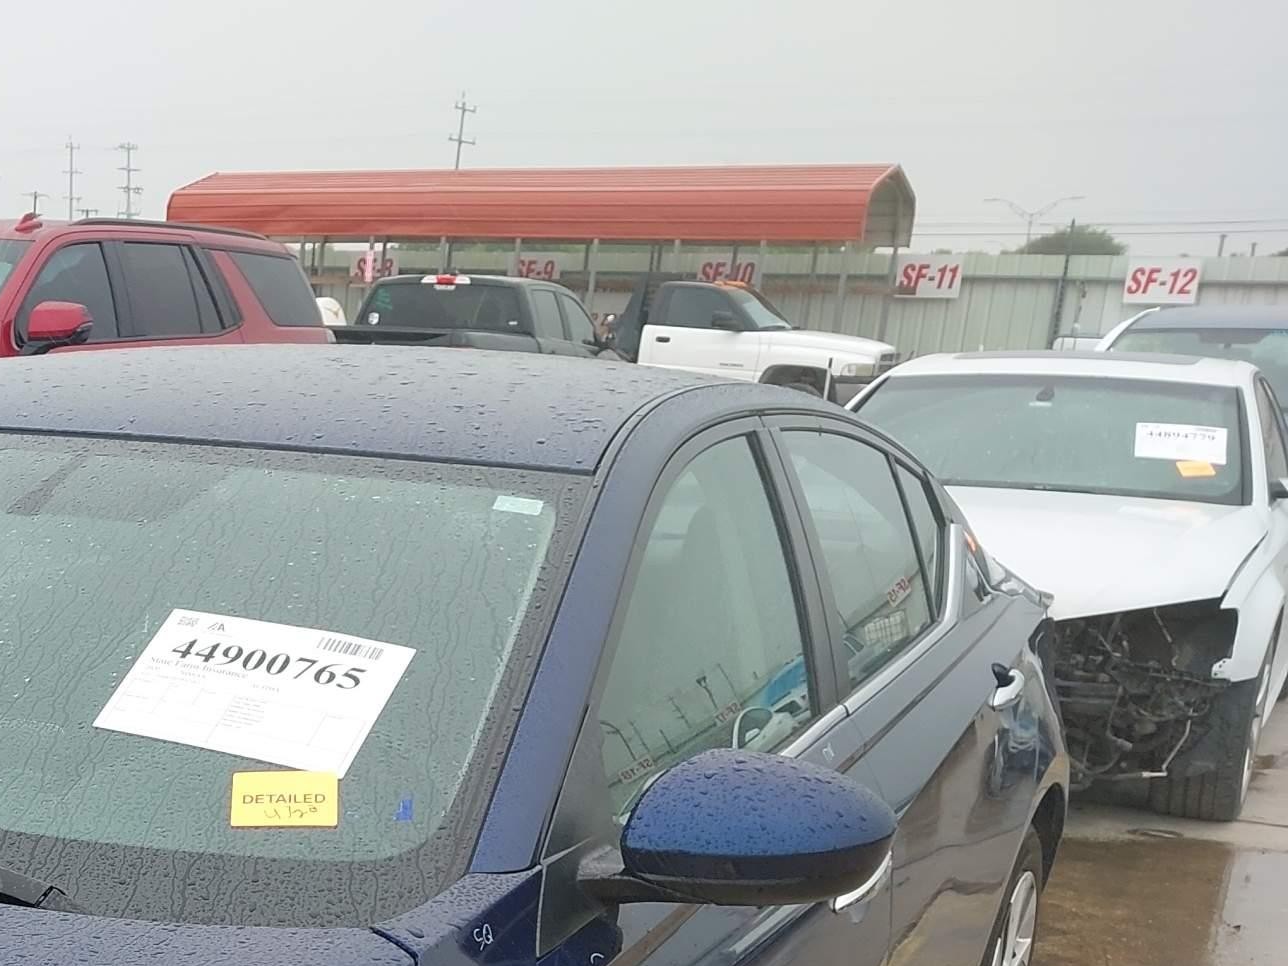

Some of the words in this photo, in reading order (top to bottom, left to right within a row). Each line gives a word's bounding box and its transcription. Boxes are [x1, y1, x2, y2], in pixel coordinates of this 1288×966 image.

[898, 263, 960, 290] SF-11
[1126, 267, 1198, 295] SF-12
[171, 638, 368, 690] 44900765
[242, 793, 326, 805] DETAILED
